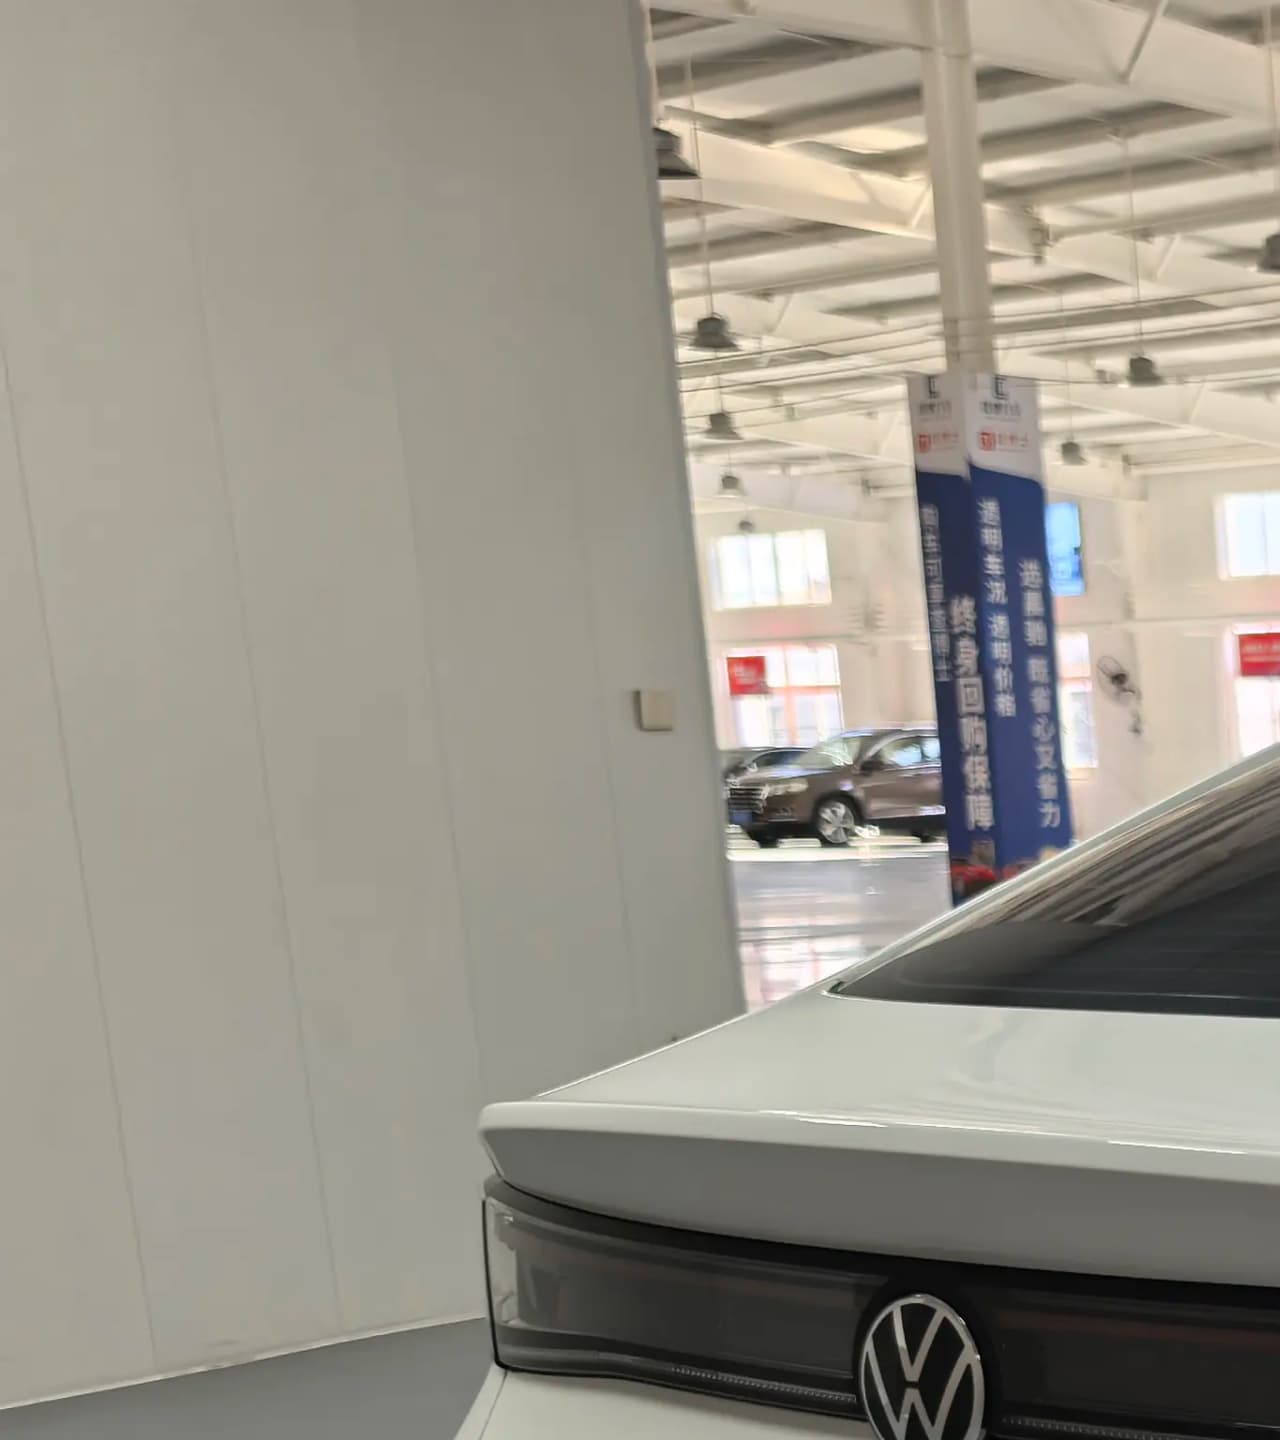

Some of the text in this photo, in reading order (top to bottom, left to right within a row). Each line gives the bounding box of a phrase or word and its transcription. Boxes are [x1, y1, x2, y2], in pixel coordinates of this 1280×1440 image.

[948, 593, 997, 832] 终身回购保障
